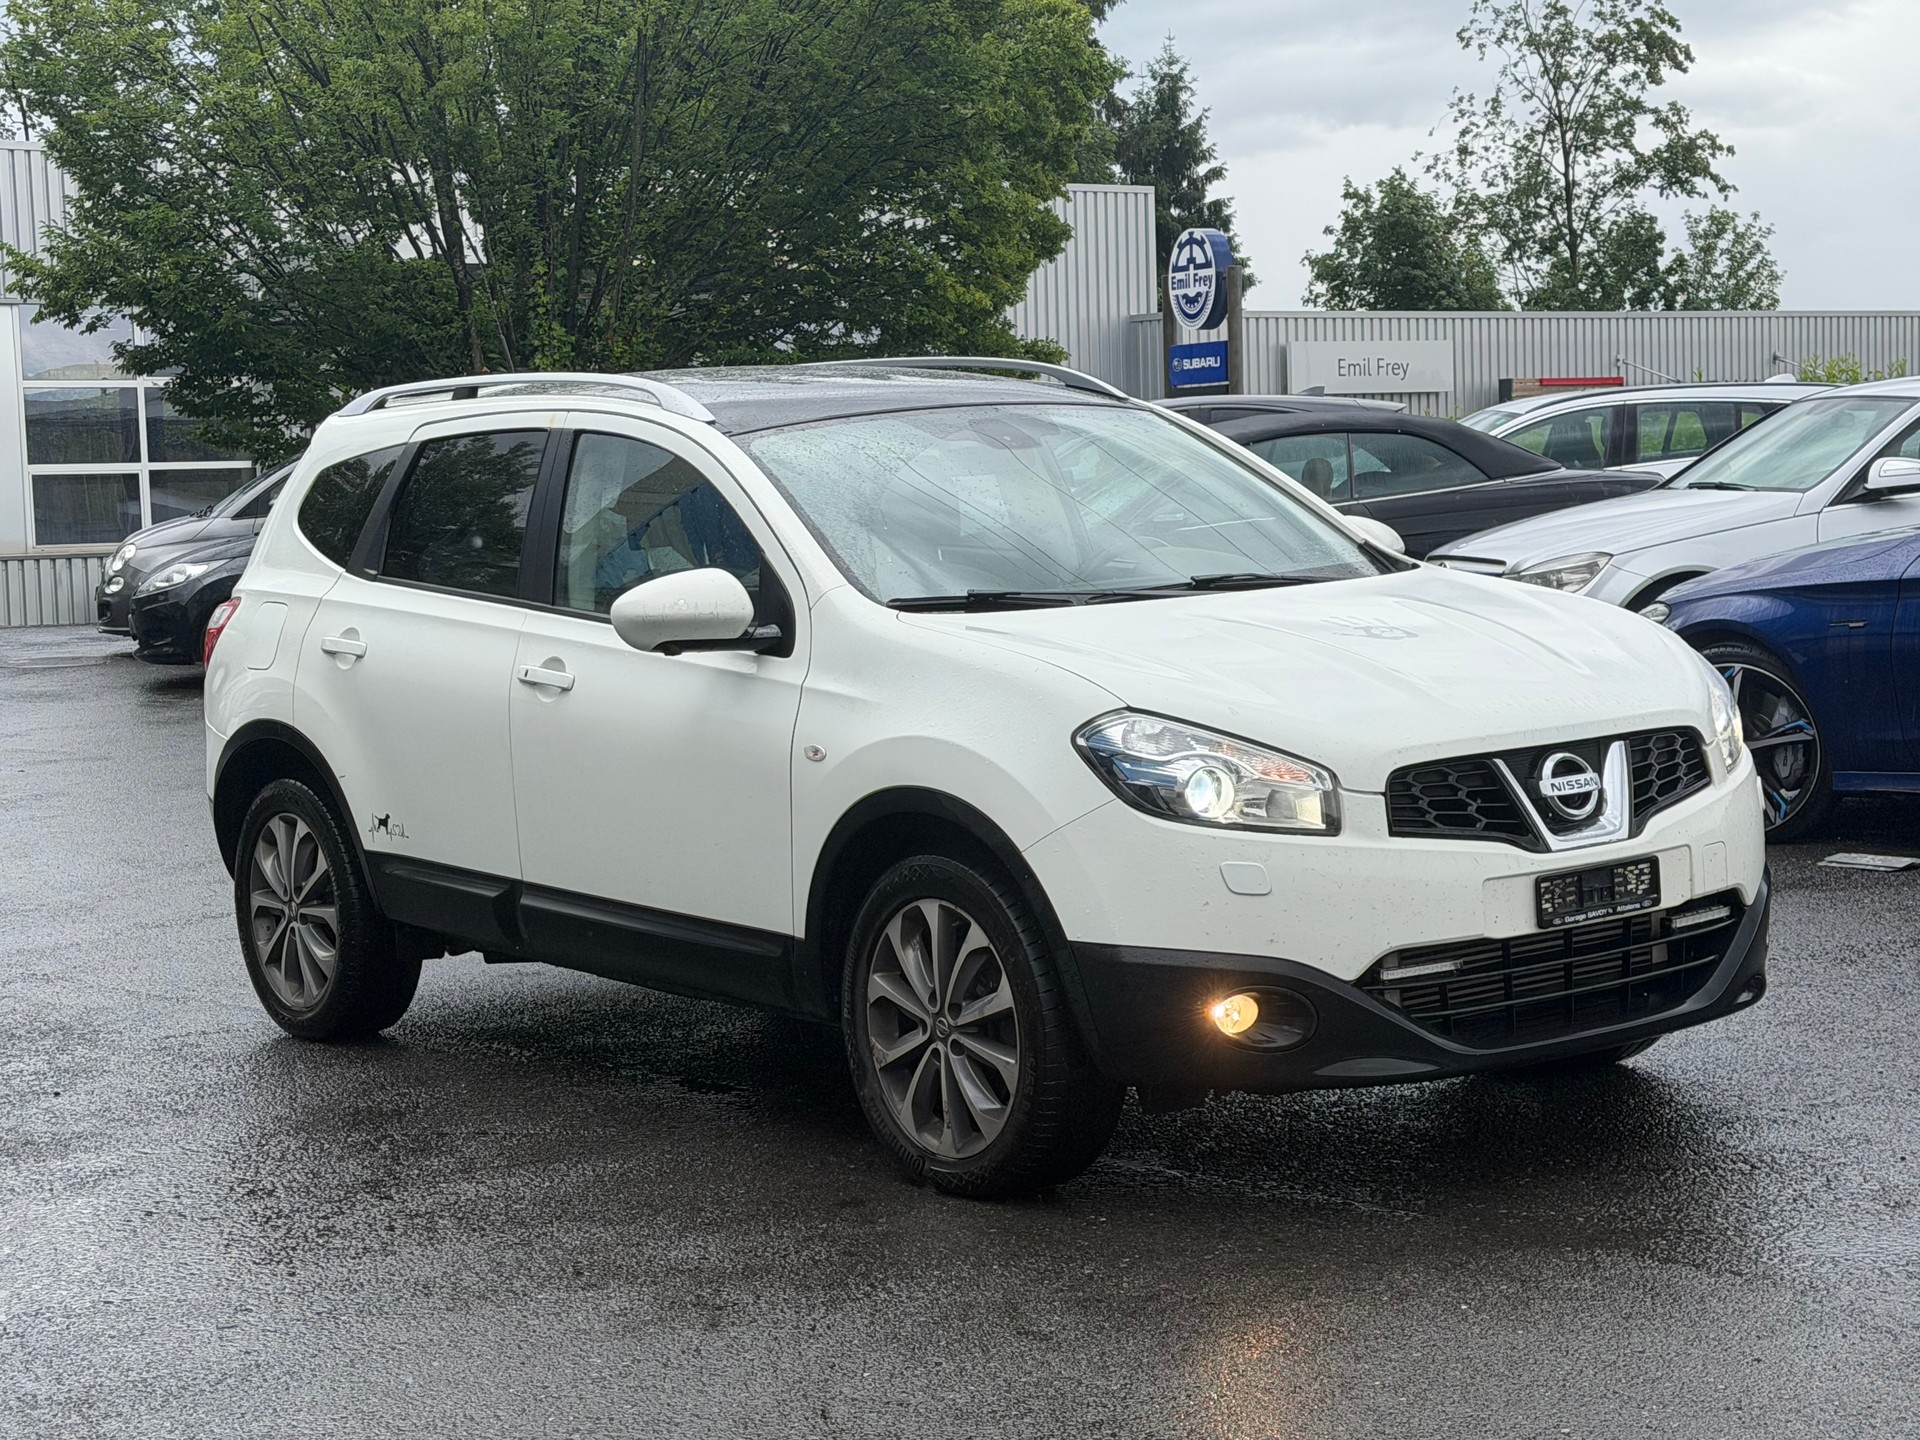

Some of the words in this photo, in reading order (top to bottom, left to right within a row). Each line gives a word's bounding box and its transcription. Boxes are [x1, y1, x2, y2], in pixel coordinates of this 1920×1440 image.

[1171, 273, 1191, 291] Emil
[1193, 273, 1213, 290] Frey
[1183, 356, 1221, 370] SUBARU
[1337, 356, 1371, 377] Emil
[1376, 357, 1410, 381] Frey
[1550, 776, 1599, 793] NISSAN
[1565, 914, 1587, 923] Garage
[1588, 909, 1607, 918] SAVOY
